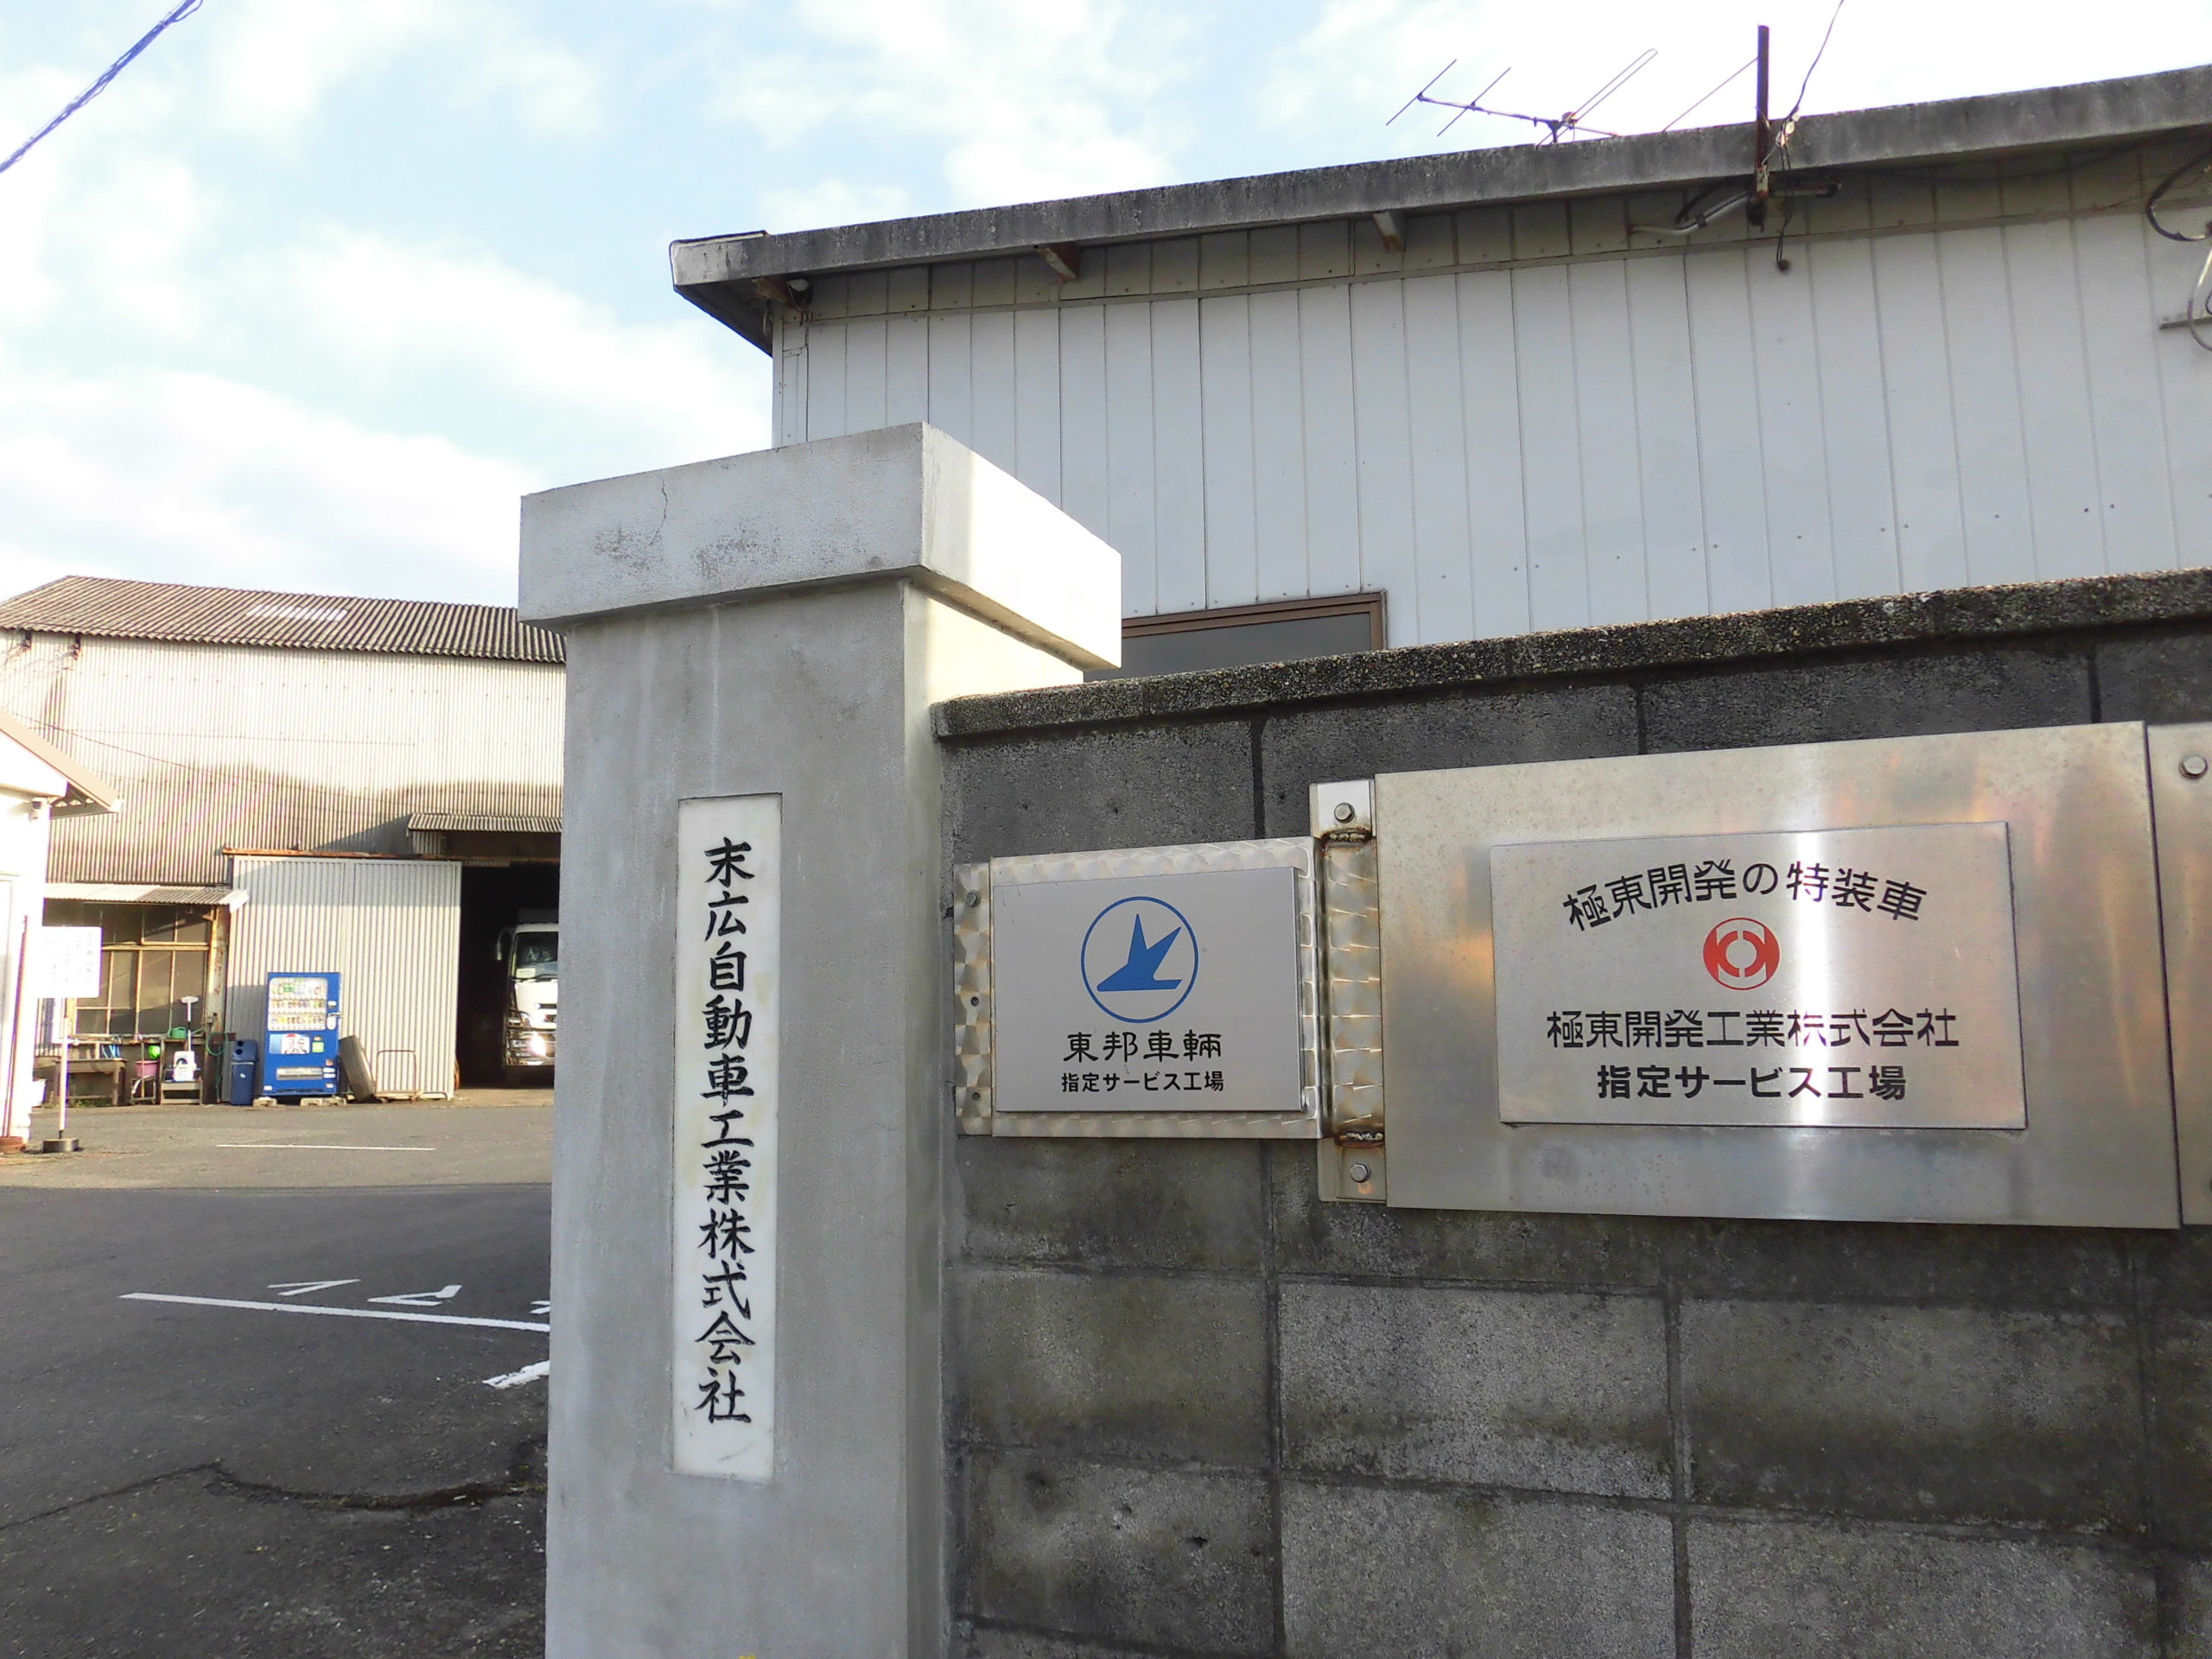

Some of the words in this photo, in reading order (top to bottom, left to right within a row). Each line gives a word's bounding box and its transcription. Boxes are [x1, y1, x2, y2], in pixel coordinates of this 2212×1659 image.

[1562, 858, 1928, 933] 極東開発の特装車
[1546, 1007, 1961, 1049] 極東開発工業株式会社
[1061, 1071, 1224, 1093] 指定サービス工場
[1597, 1064, 1907, 1101] 指定サービス工場
[695, 836, 756, 1424] 末広自動車工業株式会社
